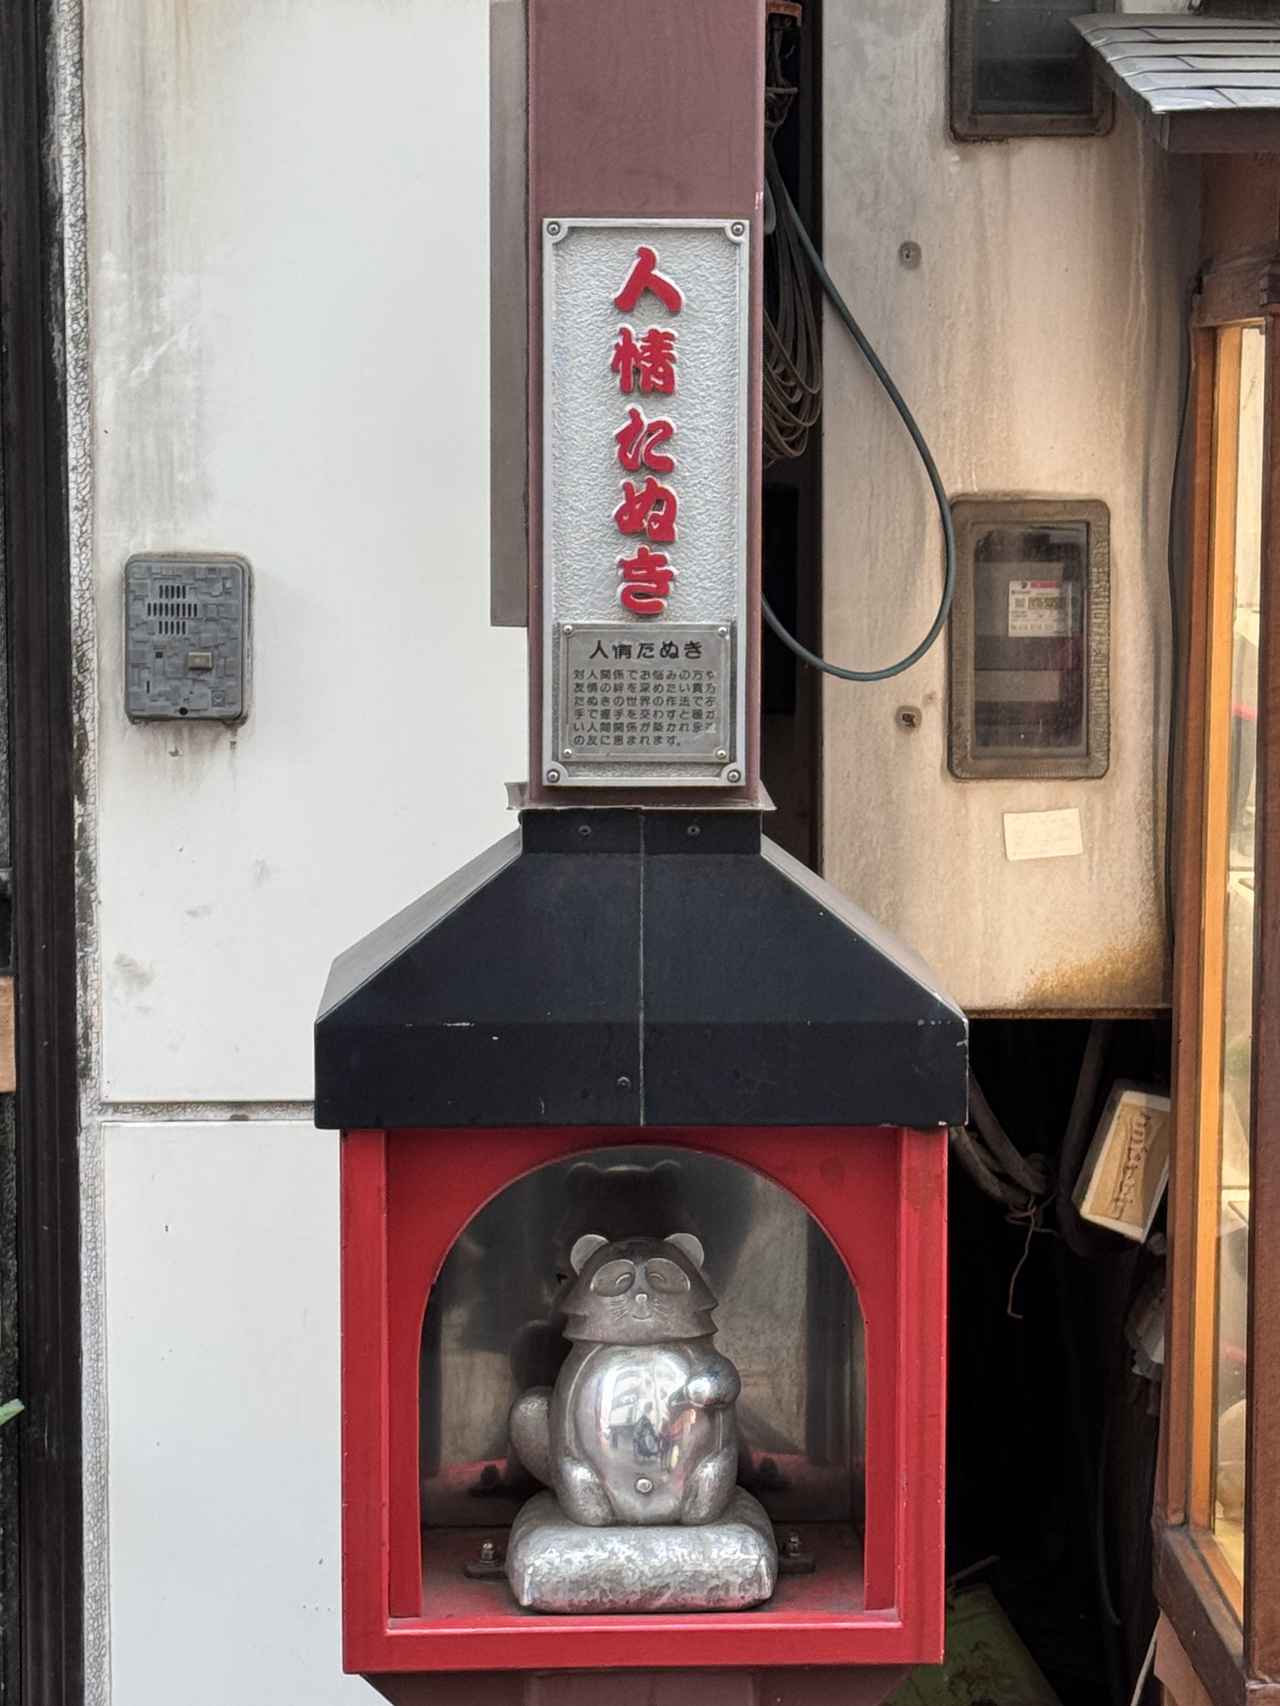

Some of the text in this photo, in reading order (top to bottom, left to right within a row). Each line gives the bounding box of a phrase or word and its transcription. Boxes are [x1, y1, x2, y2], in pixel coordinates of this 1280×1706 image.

[609, 243, 684, 616] 人情たぬき
[589, 640, 702, 660] 人情たぬき
